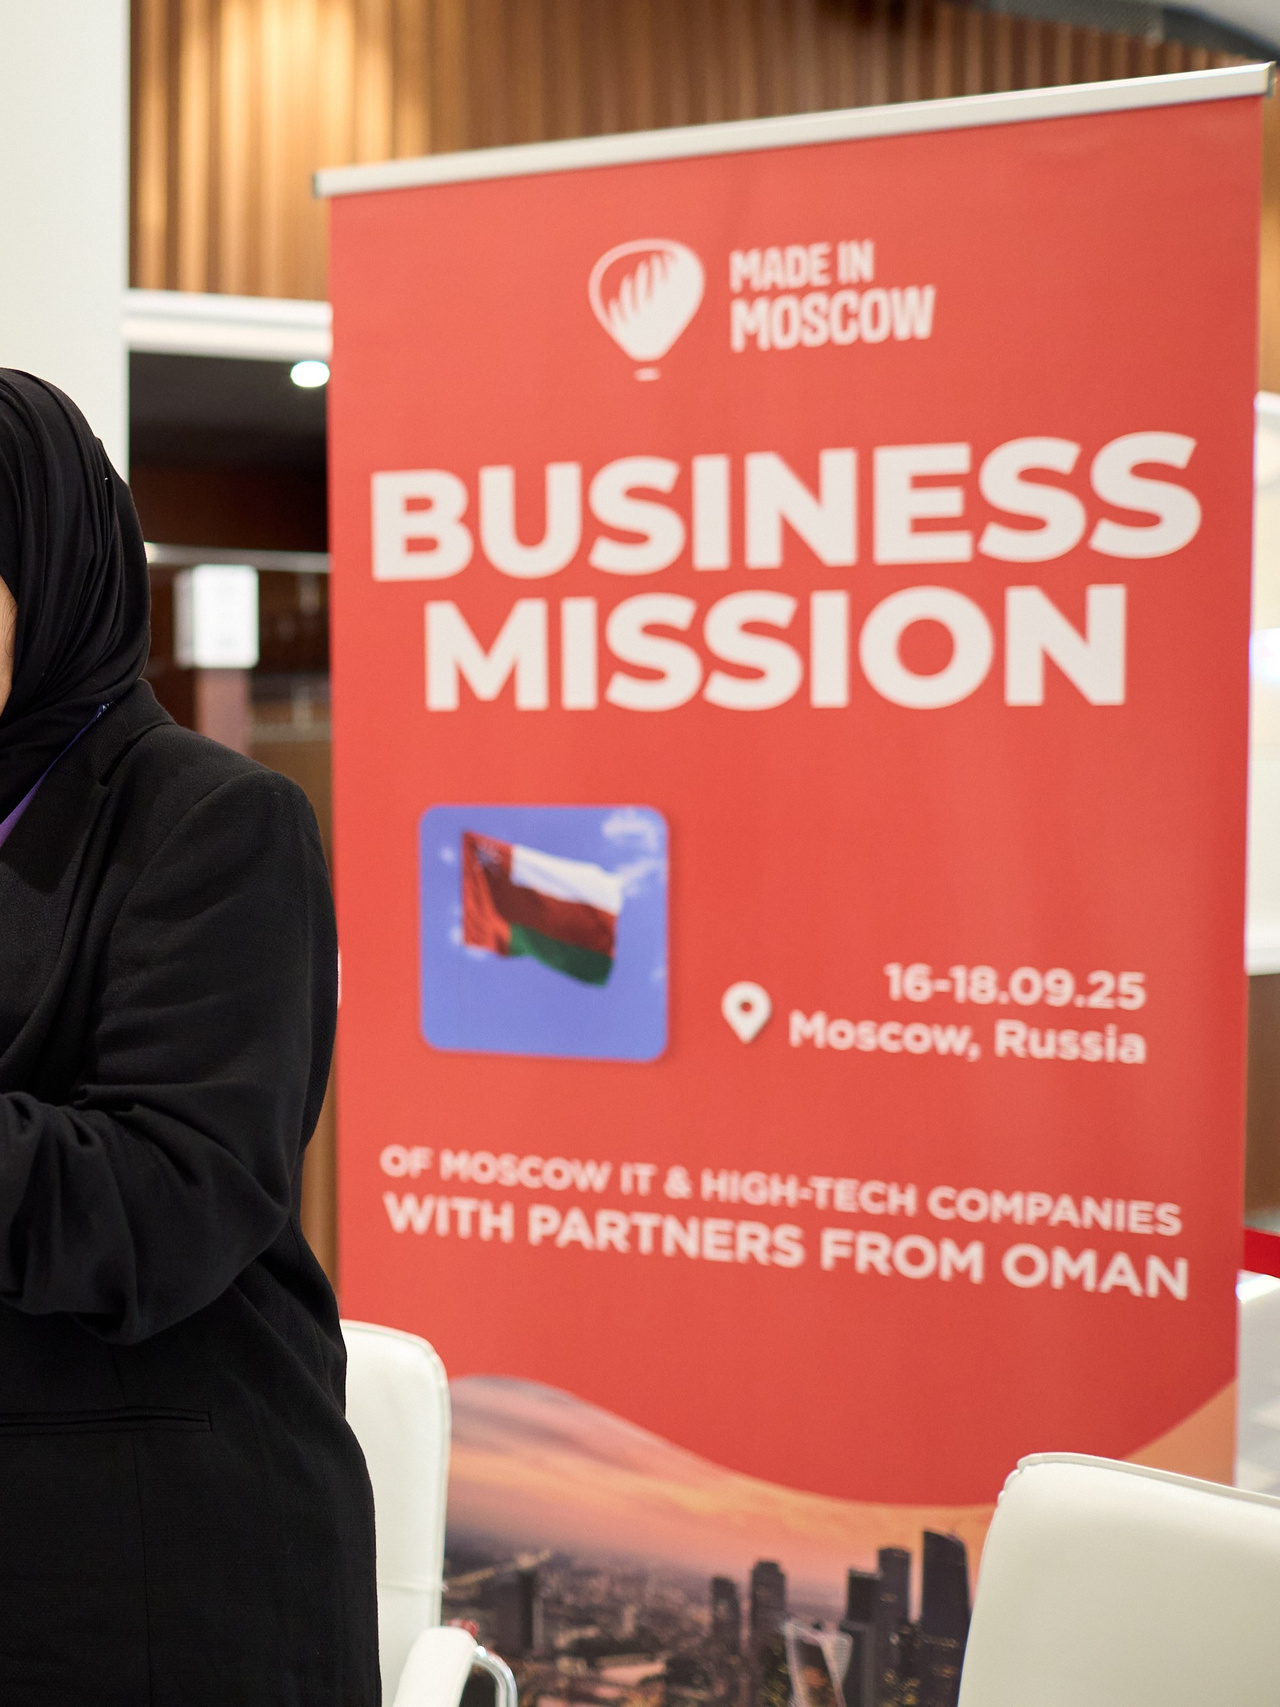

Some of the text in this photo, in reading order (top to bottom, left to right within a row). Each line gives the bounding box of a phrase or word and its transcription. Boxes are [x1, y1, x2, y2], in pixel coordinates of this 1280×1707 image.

[729, 239, 875, 293] MADE IN
[730, 285, 936, 353] MOSCOW
[370, 431, 1202, 581] BUSINESS
[425, 583, 1127, 712] MISSION
[885, 962, 1146, 1010] 16-18.09.25
[789, 1010, 1146, 1065] Moscow, Russia
[380, 1144, 1182, 1237] OF MOSCOW IT & HIGH-TECH COMPANIES
[385, 1192, 1190, 1301] WITH PARTNERS FROM OMAN
